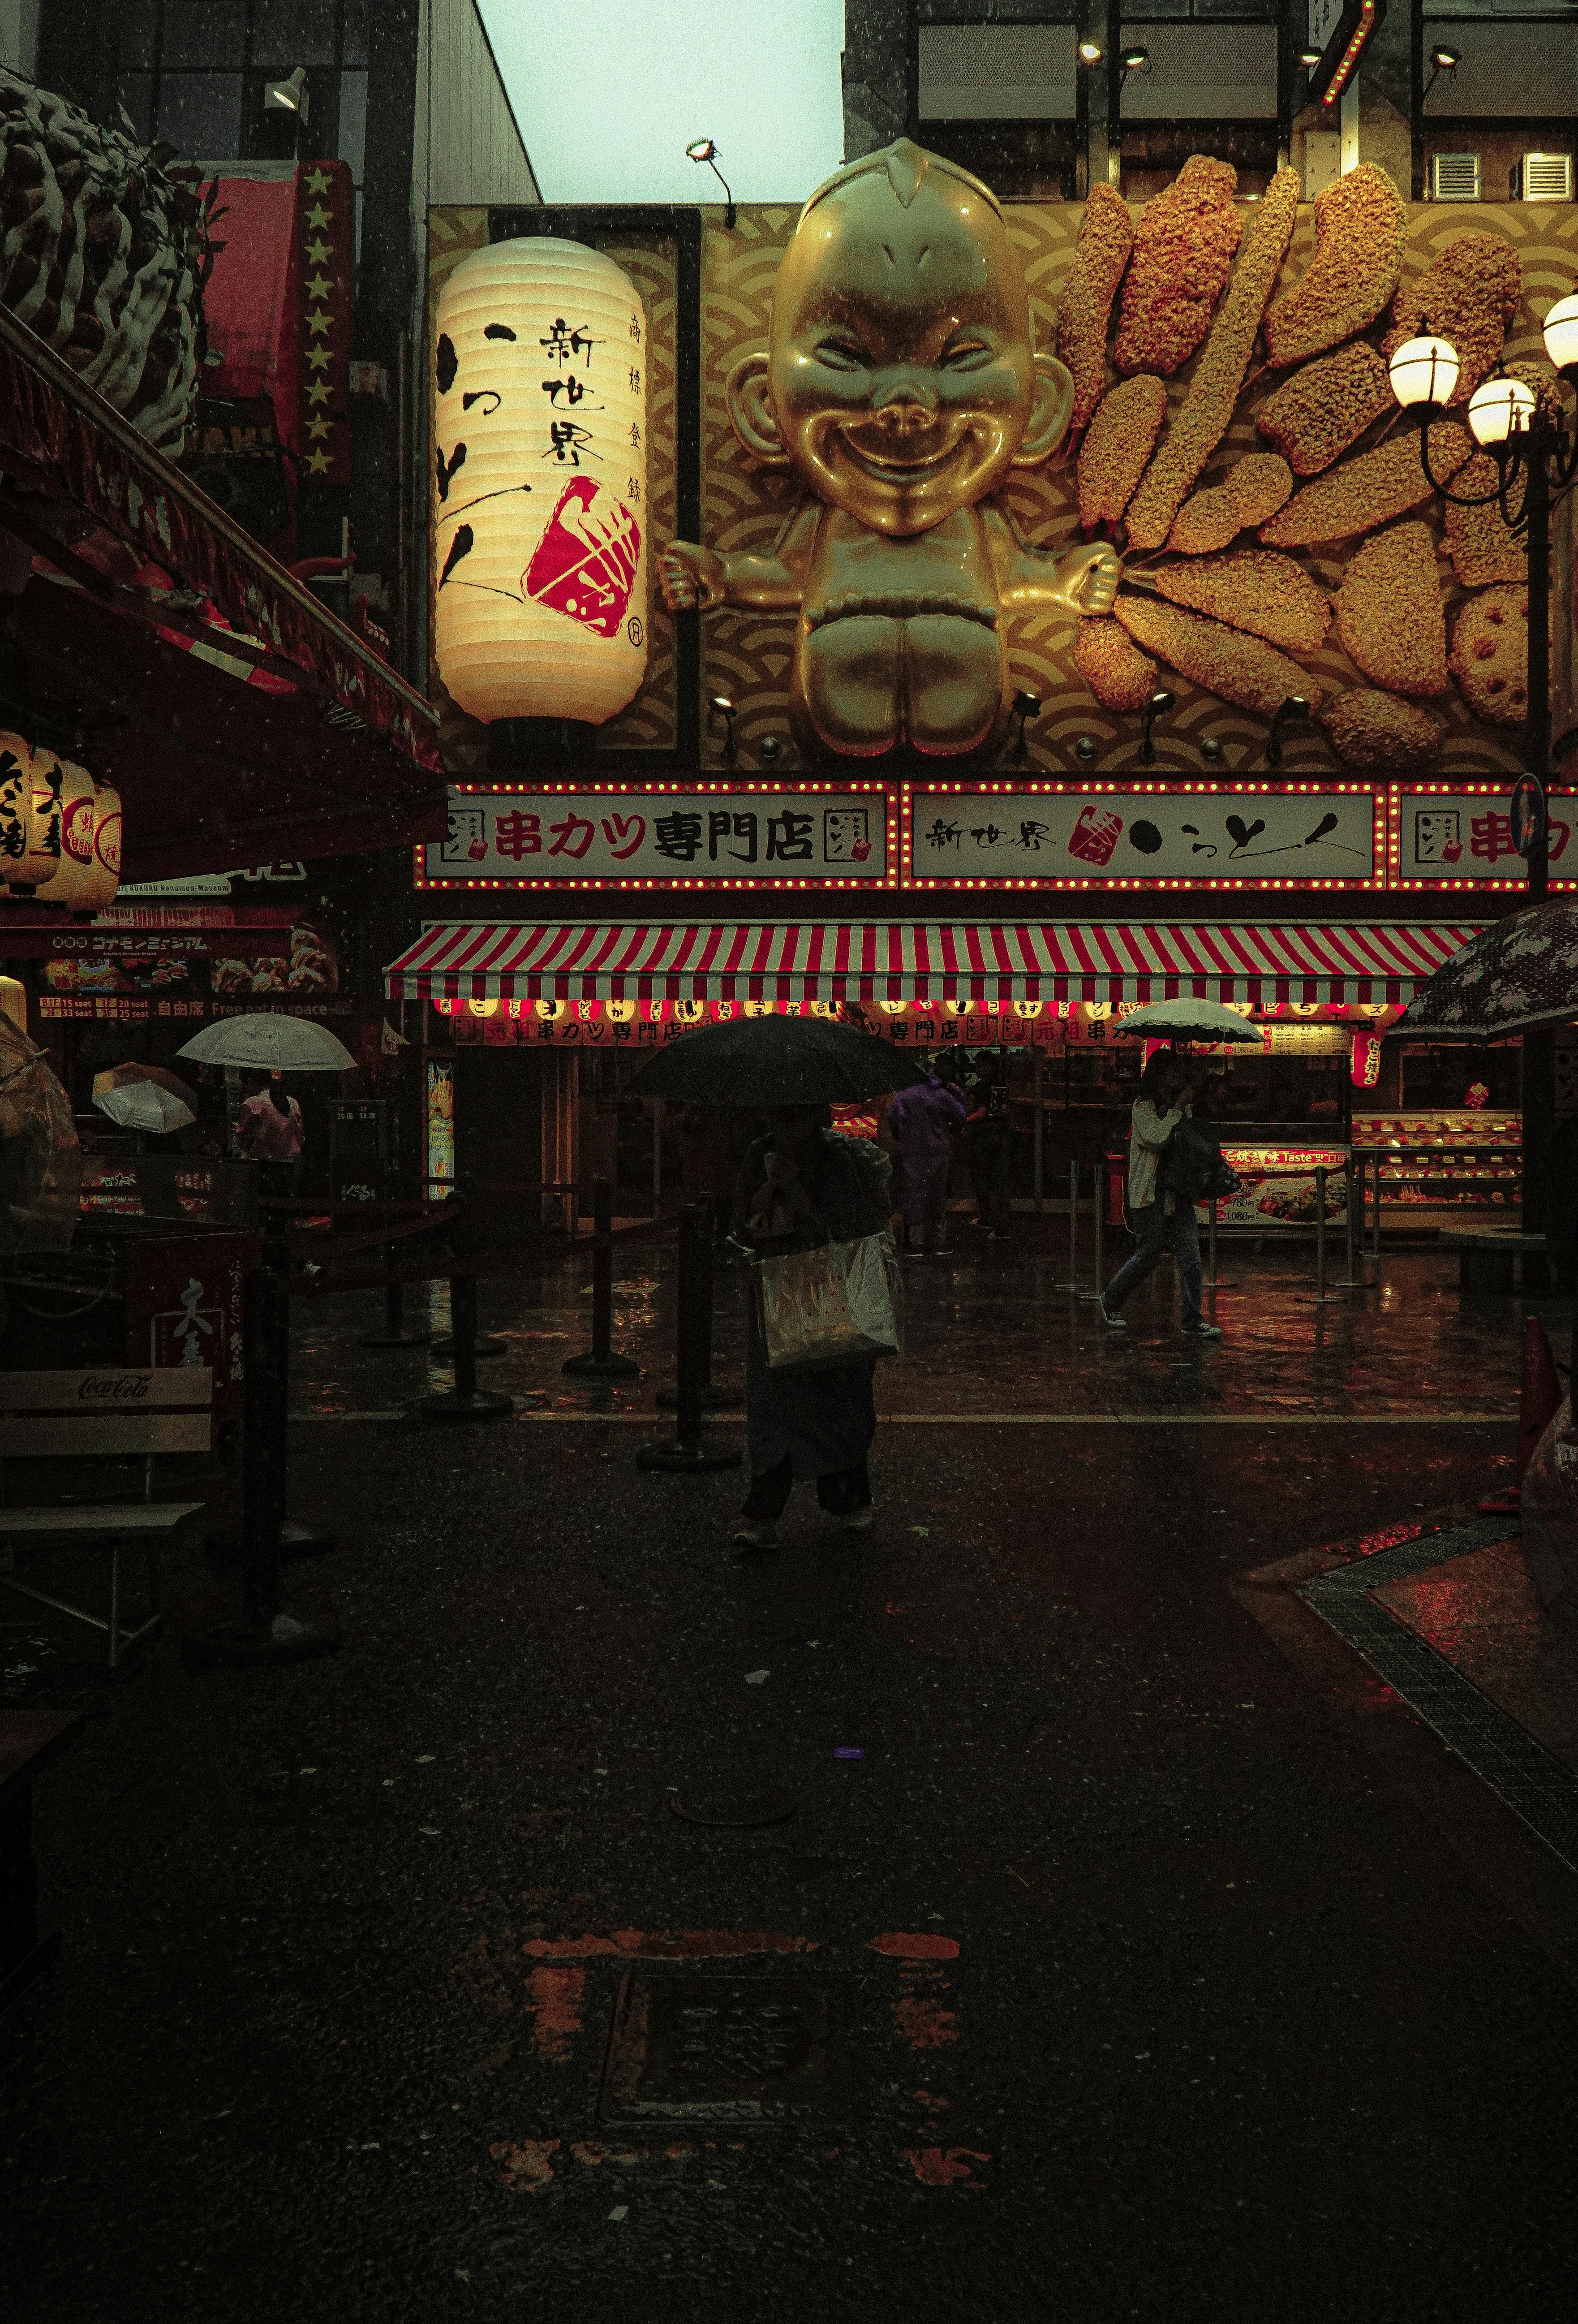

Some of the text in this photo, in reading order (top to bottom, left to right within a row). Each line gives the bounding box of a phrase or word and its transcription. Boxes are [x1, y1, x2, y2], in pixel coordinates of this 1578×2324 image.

[540, 318, 606, 467] 新世界
[628, 313, 642, 504] 商標登録
[495, 809, 814, 861] 串カツ専門店
[925, 818, 1057, 852] 新世界
[93, 937, 207, 950] コナモンミュージアム
[158, 1000, 204, 1016] 自由席
[211, 1002, 242, 1015] Free
[1364, 1038, 1380, 1084] たこ焼き
[1221, 1150, 1263, 1162] こ焼き
[1283, 1152, 1312, 1162] Taste
